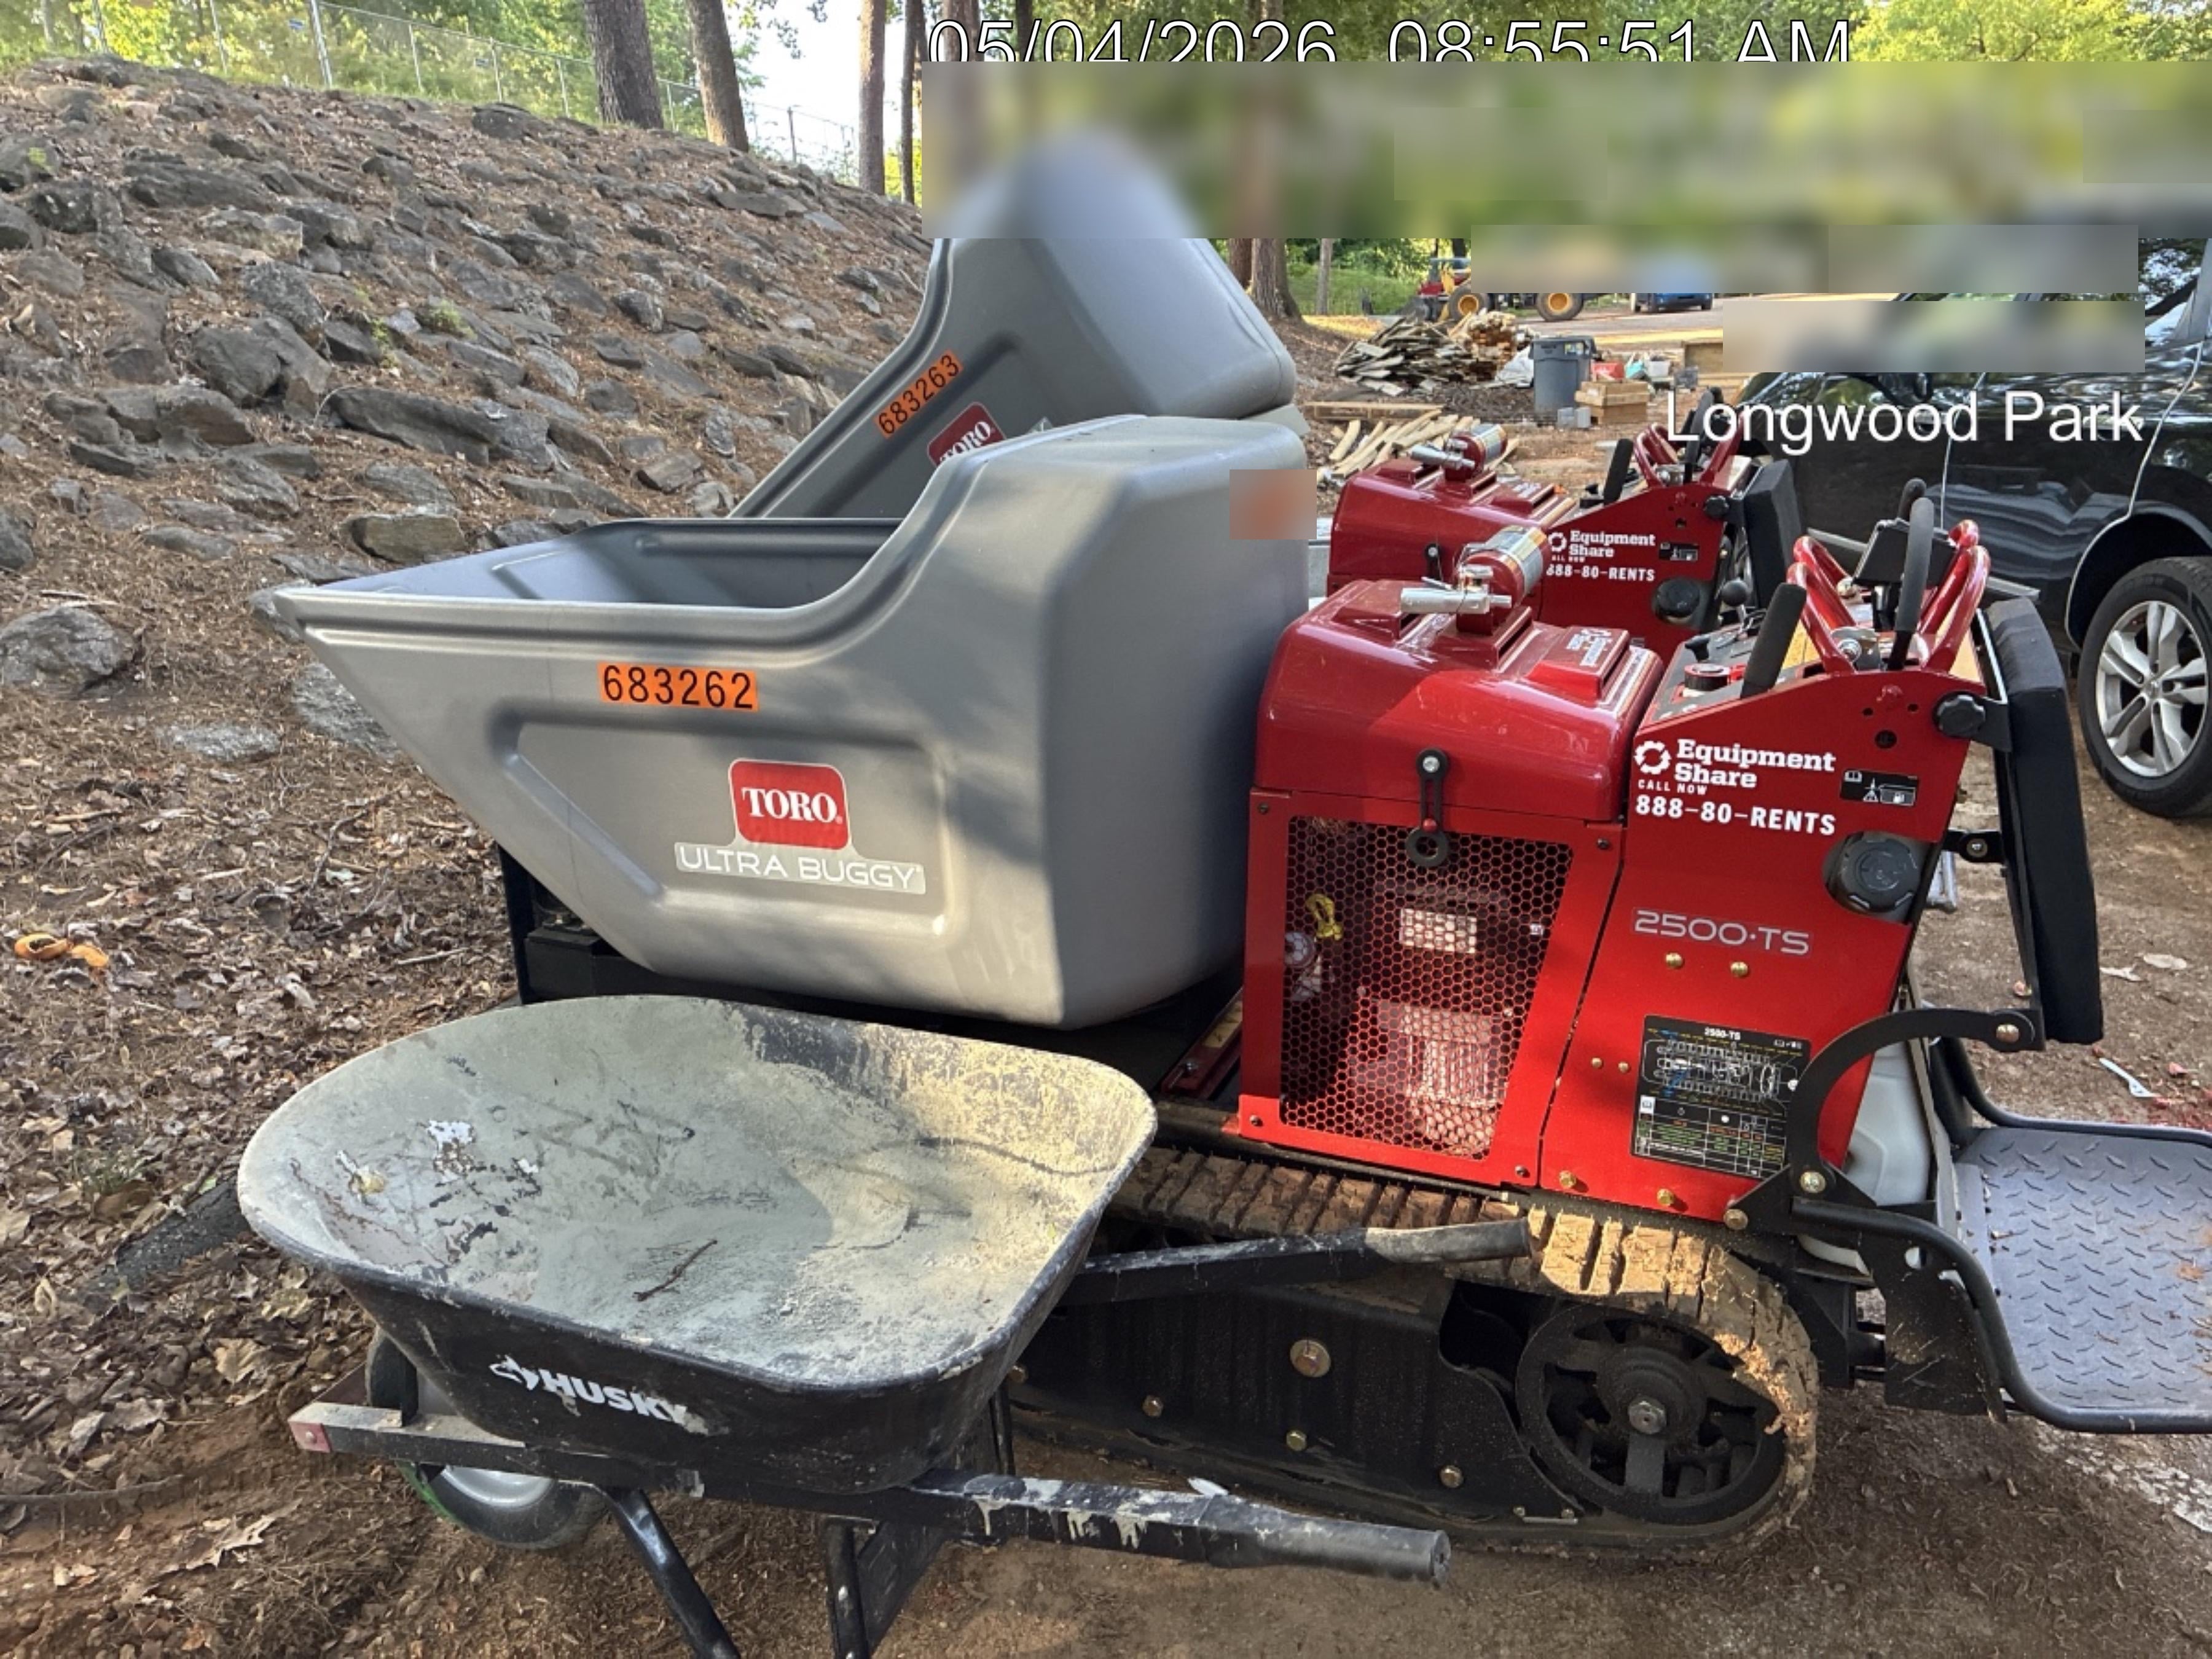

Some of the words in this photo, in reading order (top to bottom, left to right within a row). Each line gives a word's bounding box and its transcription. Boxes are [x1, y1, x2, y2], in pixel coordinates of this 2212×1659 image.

[878, 355, 959, 434] 683263
[1569, 543, 1614, 558] Share
[1570, 530, 1656, 546] Equipment
[603, 665, 753, 709] 683262
[1677, 738, 1837, 773] Equipment
[1637, 779, 1671, 791] CALL
[1677, 782, 1708, 796] NOW
[1674, 762, 1757, 788] Share
[1635, 794, 1837, 836] 888-80-RENTS
[678, 845, 788, 877] ULTRA
[799, 856, 916, 889] BUGGY
[538, 1368, 688, 1427] HUSKY
